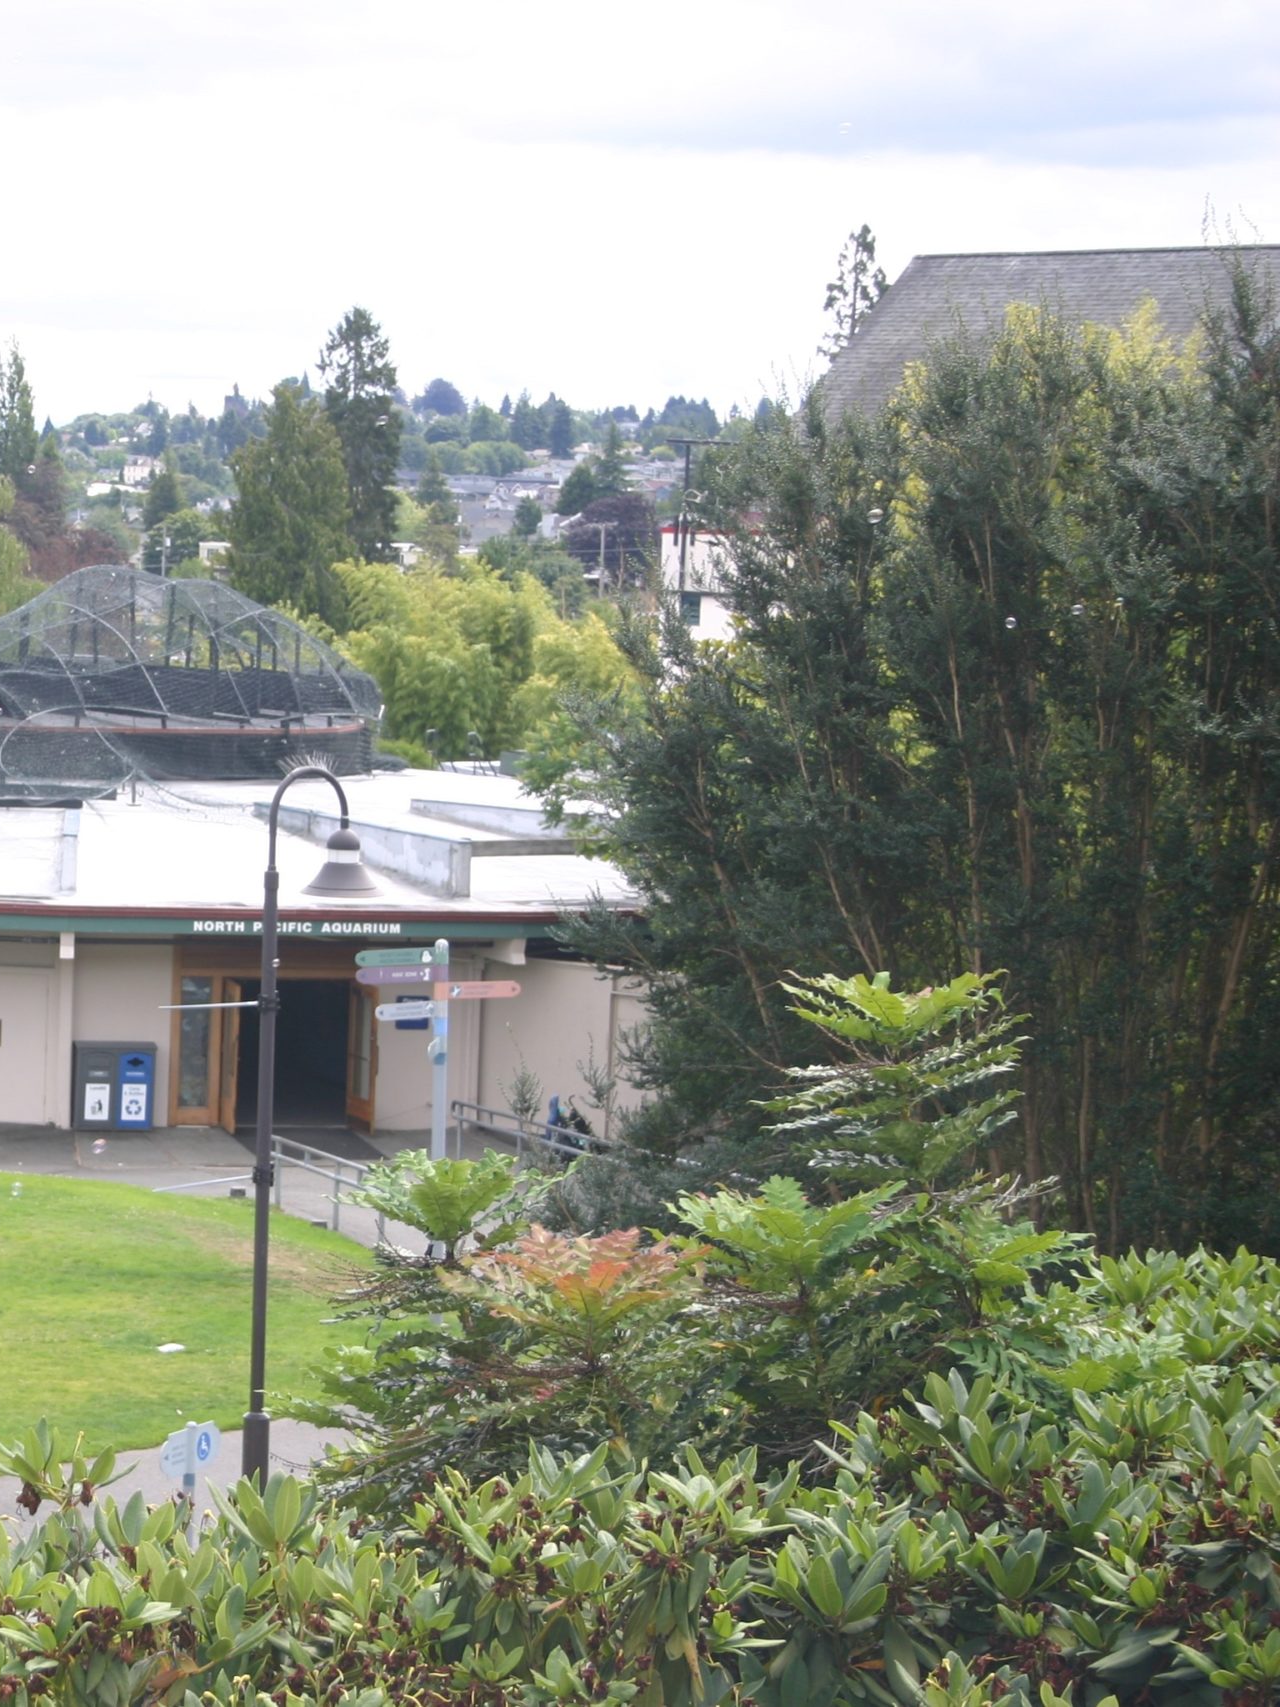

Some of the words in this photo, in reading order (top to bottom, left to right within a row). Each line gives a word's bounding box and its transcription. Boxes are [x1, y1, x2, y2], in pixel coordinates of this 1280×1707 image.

[193, 920, 245, 932] NORTH
[253, 921, 313, 933] PCIFIC
[321, 922, 401, 934] AQUARIUM
